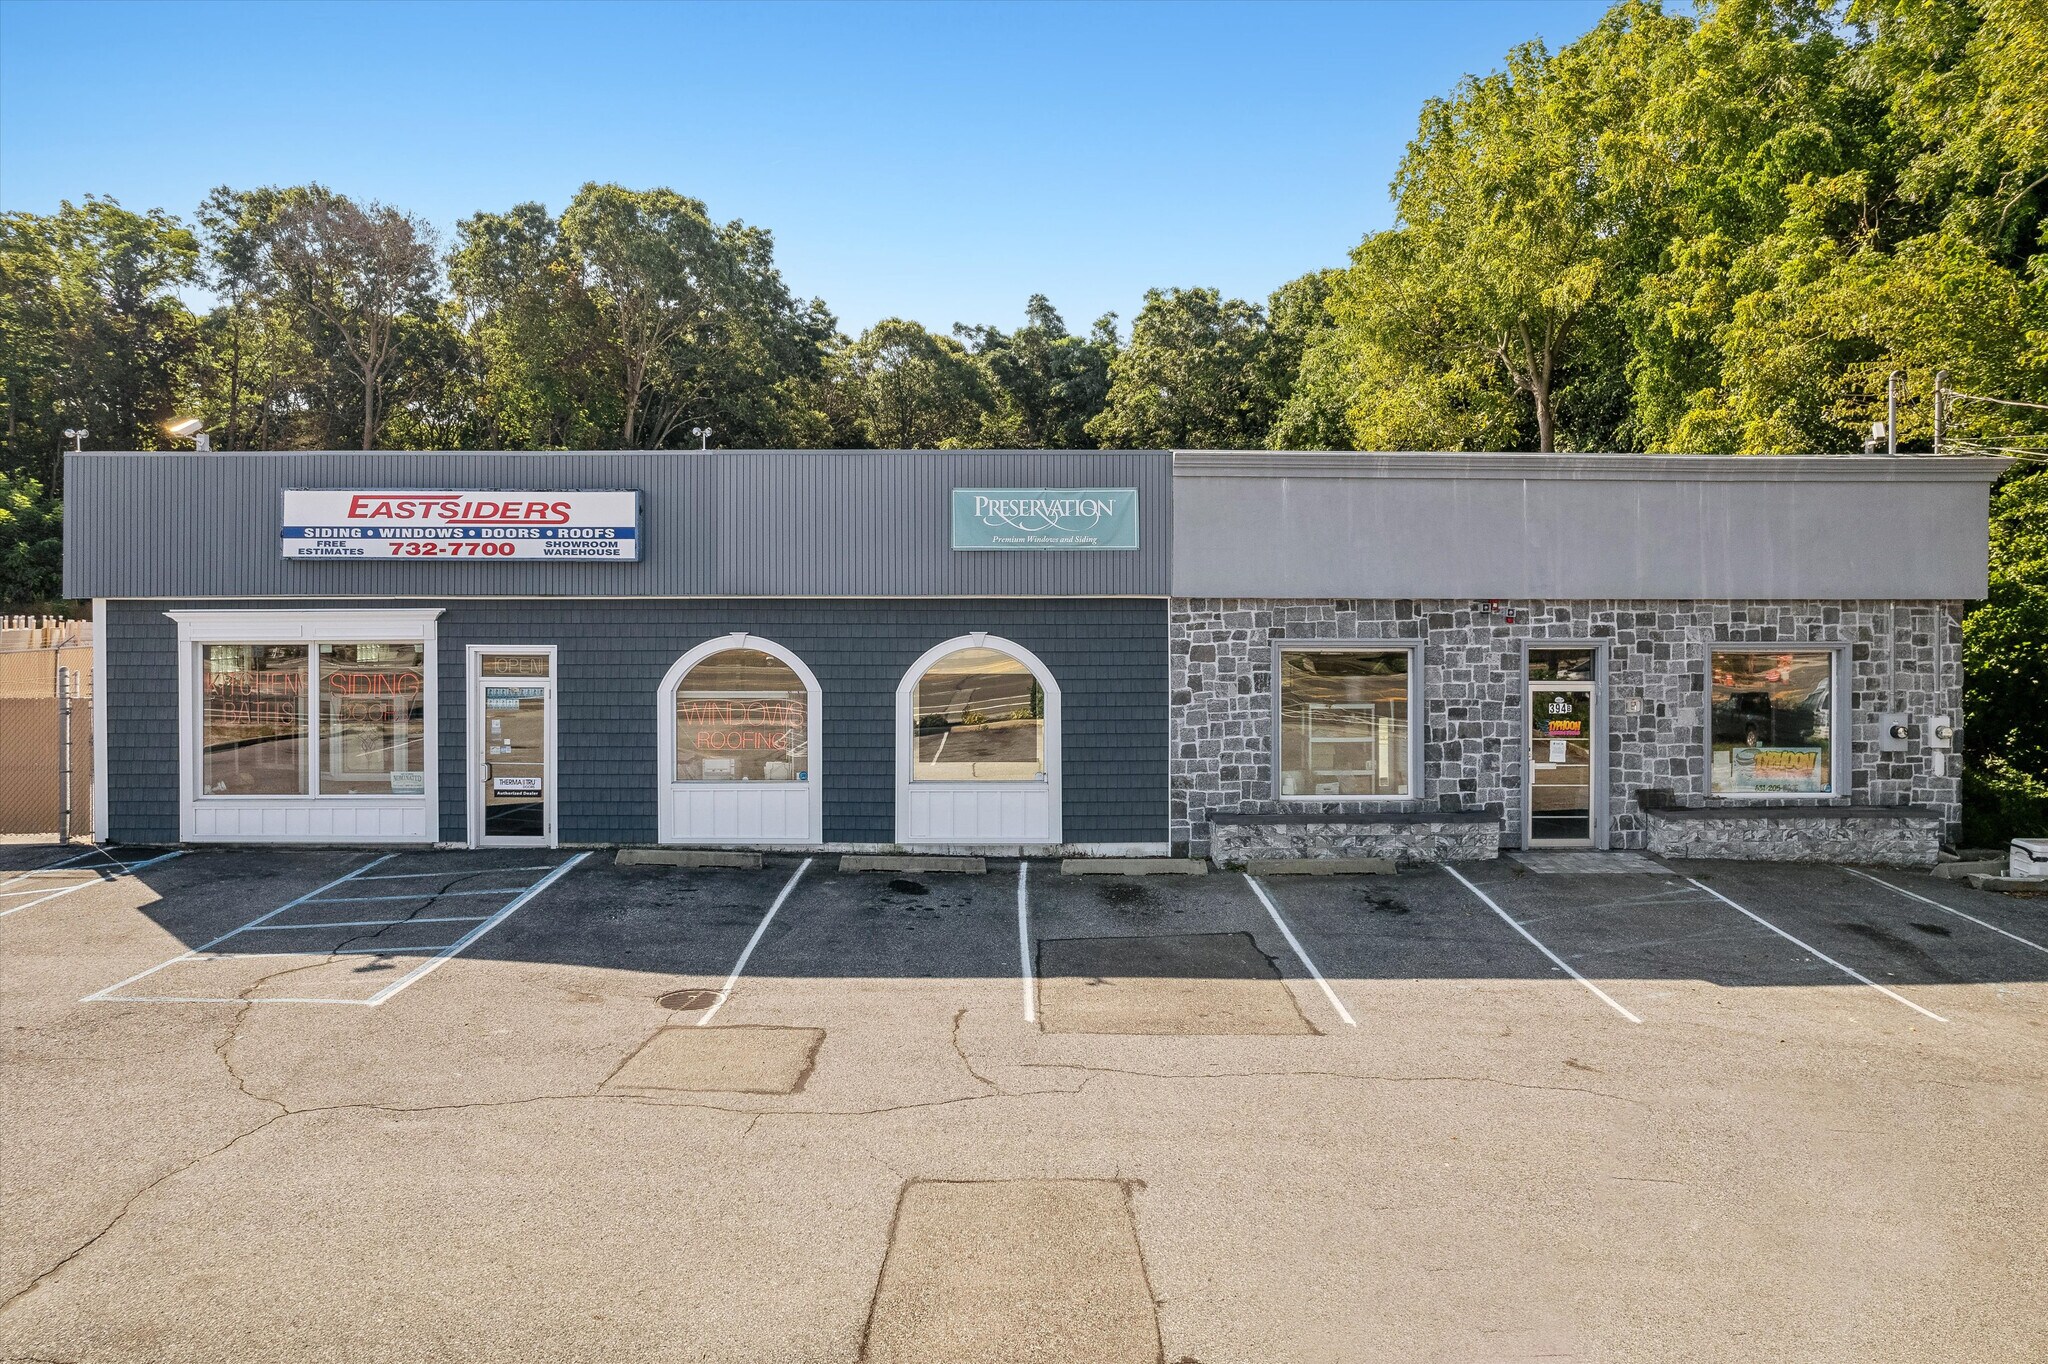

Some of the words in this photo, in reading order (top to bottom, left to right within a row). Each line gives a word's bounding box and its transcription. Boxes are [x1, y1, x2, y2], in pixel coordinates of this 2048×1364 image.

[347, 494, 572, 525] EASTSIDERS
[974, 496, 1116, 530] PRESERVATION
[304, 528, 363, 538] SIDING
[379, 528, 464, 538] WINDOWS
[481, 528, 540, 538] DOORS
[557, 528, 616, 538] ROOFS
[992, 535, 1025, 543] Premium
[1027, 535, 1058, 543] Windows
[1060, 535, 1073, 543] and
[1074, 535, 1098, 544] Siding
[298, 547, 364, 556] ESTIMATES
[316, 540, 346, 548] FREE
[388, 542, 516, 556] 732-7700
[545, 541, 619, 549] SHOWROOM
[543, 548, 621, 556] WAREHOUSE
[496, 658, 541, 674] OPEN
[206, 672, 308, 696] KITCHENS
[329, 672, 419, 699] SIDING
[223, 701, 294, 725] BATHS
[682, 701, 804, 727] WINDOWS
[1548, 720, 1582, 731] TYPHOON
[696, 731, 787, 750] ROOFING
[1754, 751, 1818, 770] TYPHOON
[1754, 784, 1799, 792] 631-205-
